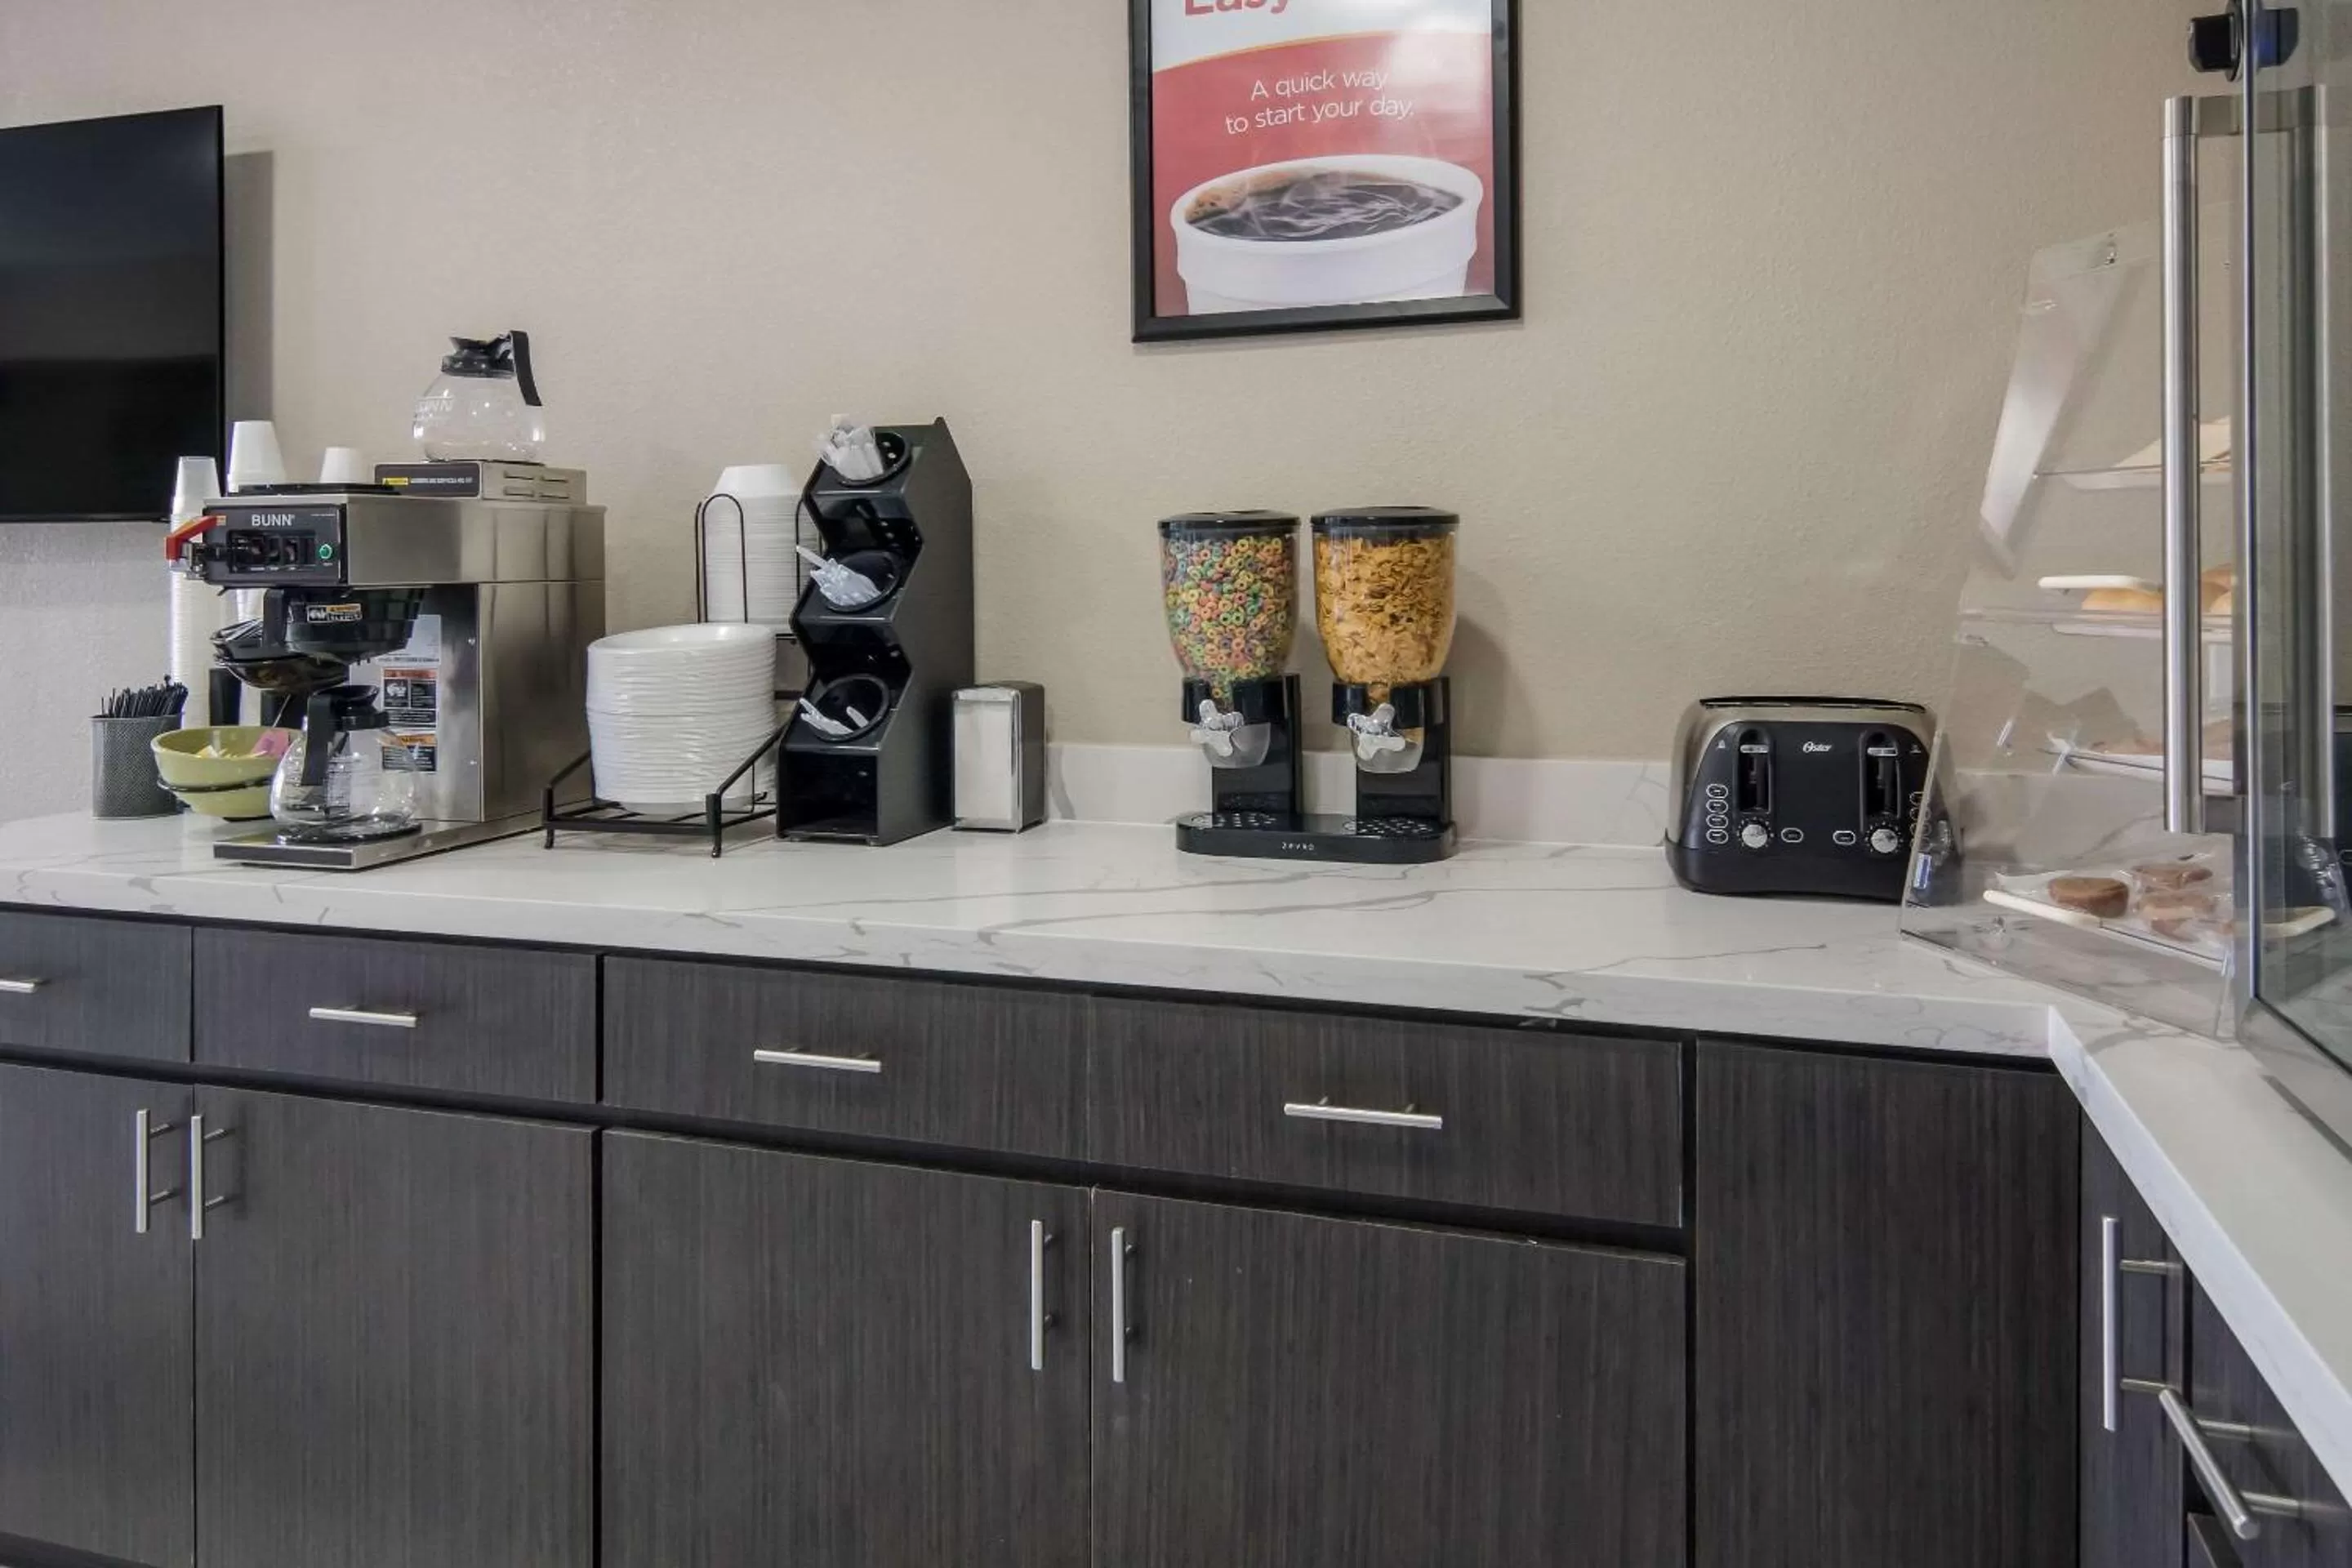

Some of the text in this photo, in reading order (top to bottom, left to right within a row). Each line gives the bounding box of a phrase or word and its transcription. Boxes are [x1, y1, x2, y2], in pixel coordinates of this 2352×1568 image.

[1250, 69, 1388, 101] A quick way
[1226, 96, 1415, 135] to start your day.
